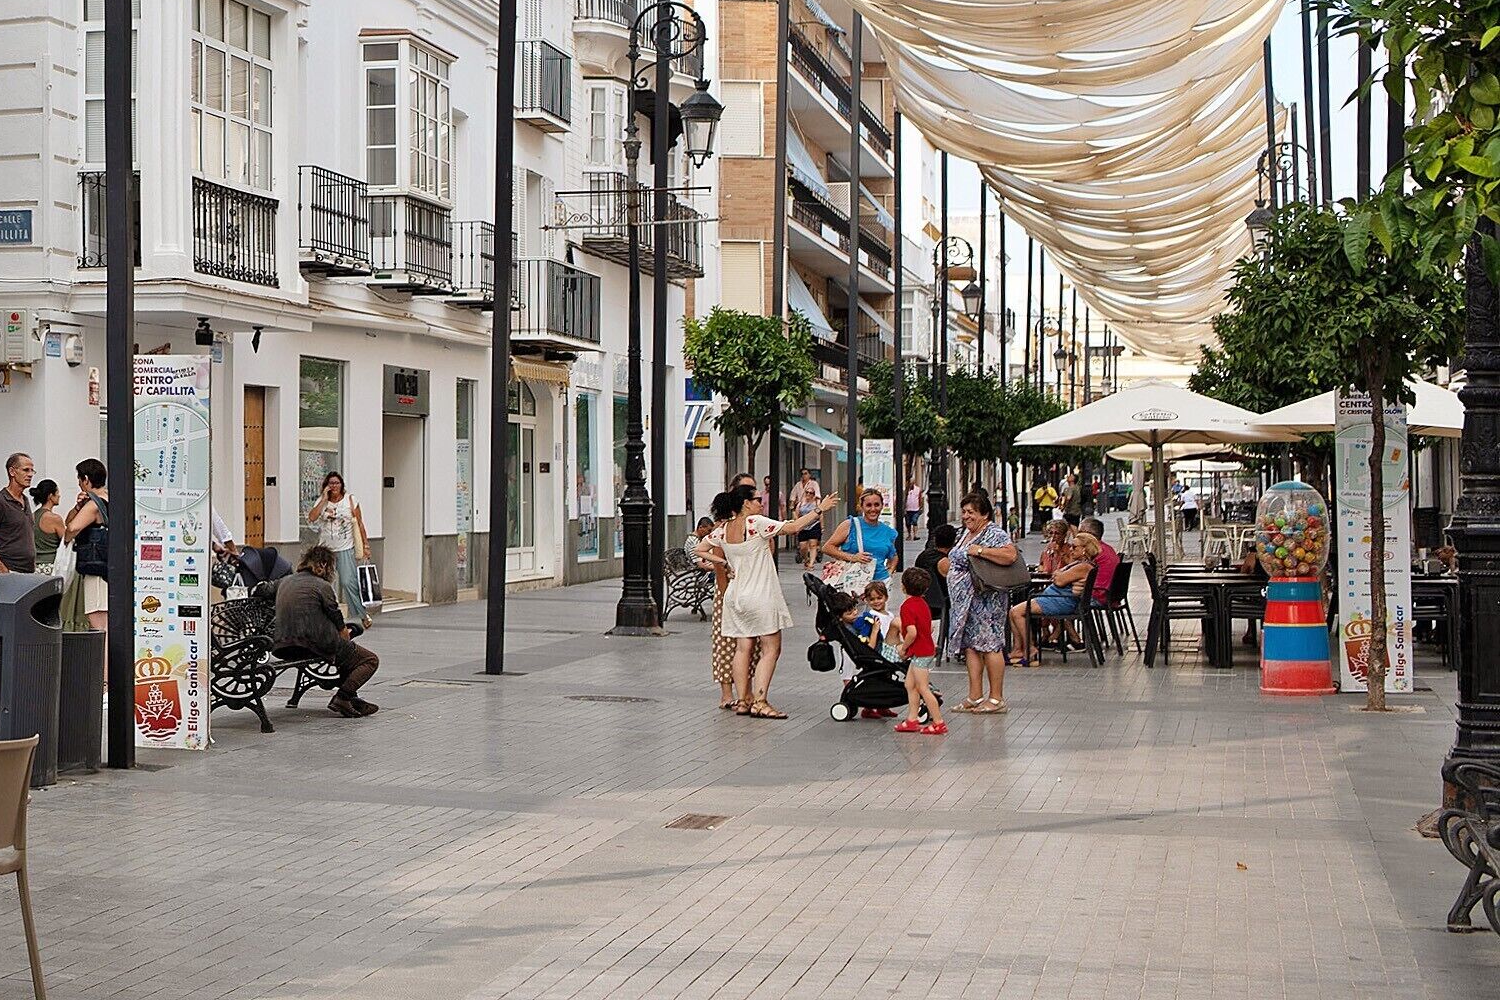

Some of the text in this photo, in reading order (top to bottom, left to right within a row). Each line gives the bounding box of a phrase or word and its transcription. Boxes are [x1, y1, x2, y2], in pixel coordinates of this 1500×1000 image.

[134, 376, 173, 384] CENTRO
[146, 387, 195, 396] CAPILLITA
[1395, 653, 1406, 677] Elige
[188, 639, 200, 732] Elige Sanlúcar
